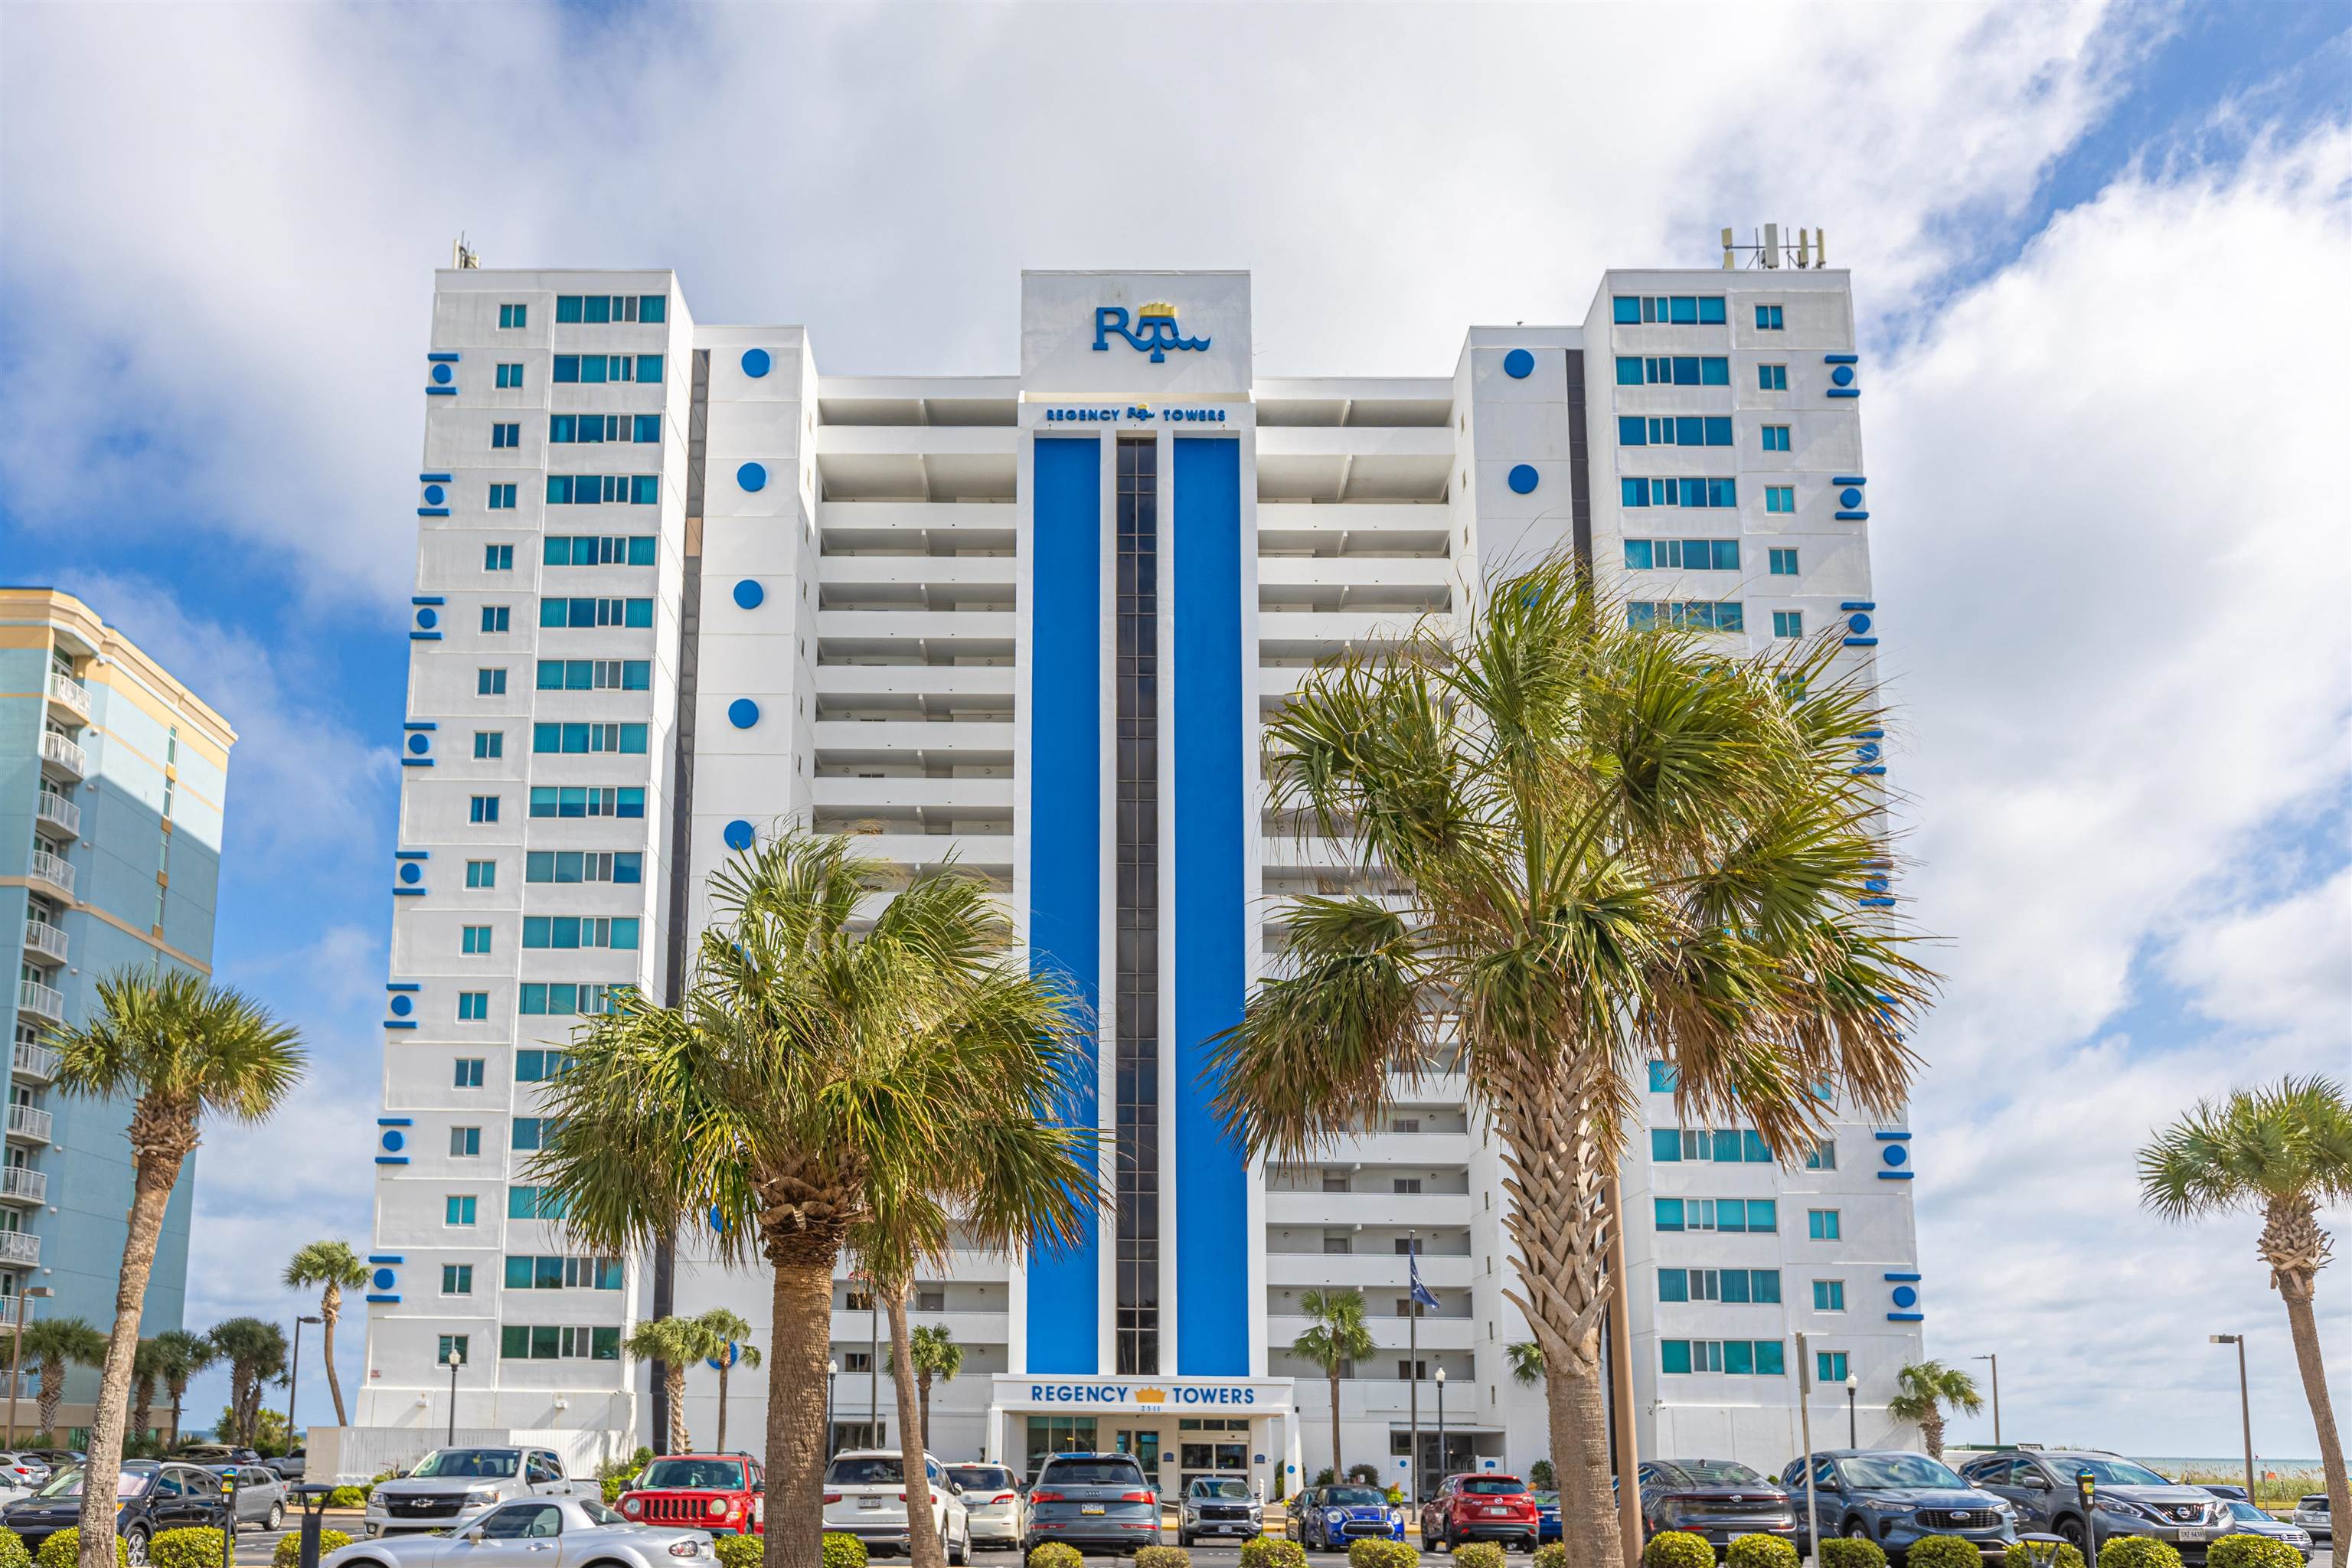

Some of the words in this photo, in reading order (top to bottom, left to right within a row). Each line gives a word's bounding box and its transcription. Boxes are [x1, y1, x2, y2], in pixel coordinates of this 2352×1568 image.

[1046, 409, 1120, 421] REGENCY
[1163, 409, 1226, 422] TOWERS
[1031, 1385, 1129, 1402] REGENCY
[1172, 1387, 1254, 1404] TOWERS
